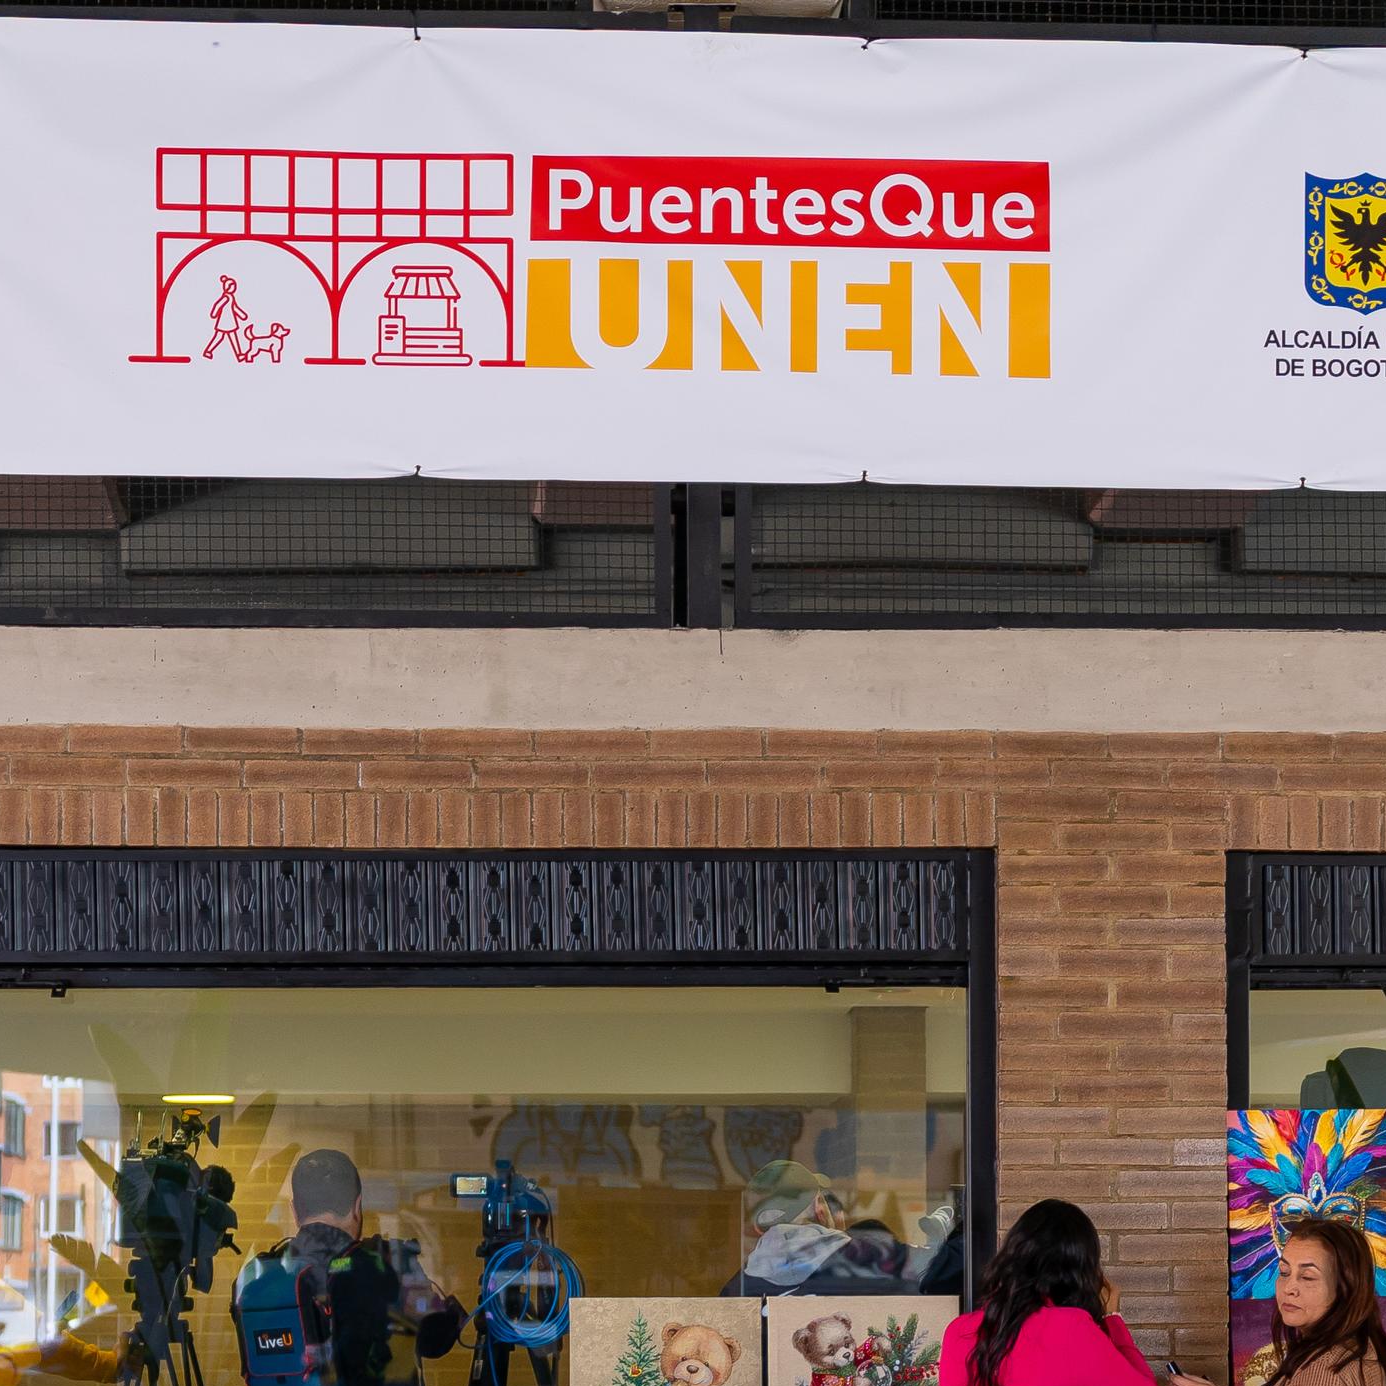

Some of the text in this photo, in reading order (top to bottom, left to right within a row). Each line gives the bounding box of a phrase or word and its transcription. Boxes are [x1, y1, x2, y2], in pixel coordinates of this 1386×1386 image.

[548, 168, 1035, 239] PuentesQue
[569, 258, 1010, 377] UNEN
[1263, 325, 1381, 350] ALCALDÍA
[1275, 358, 1305, 377] DE
[258, 1332, 293, 1349] LiveU
